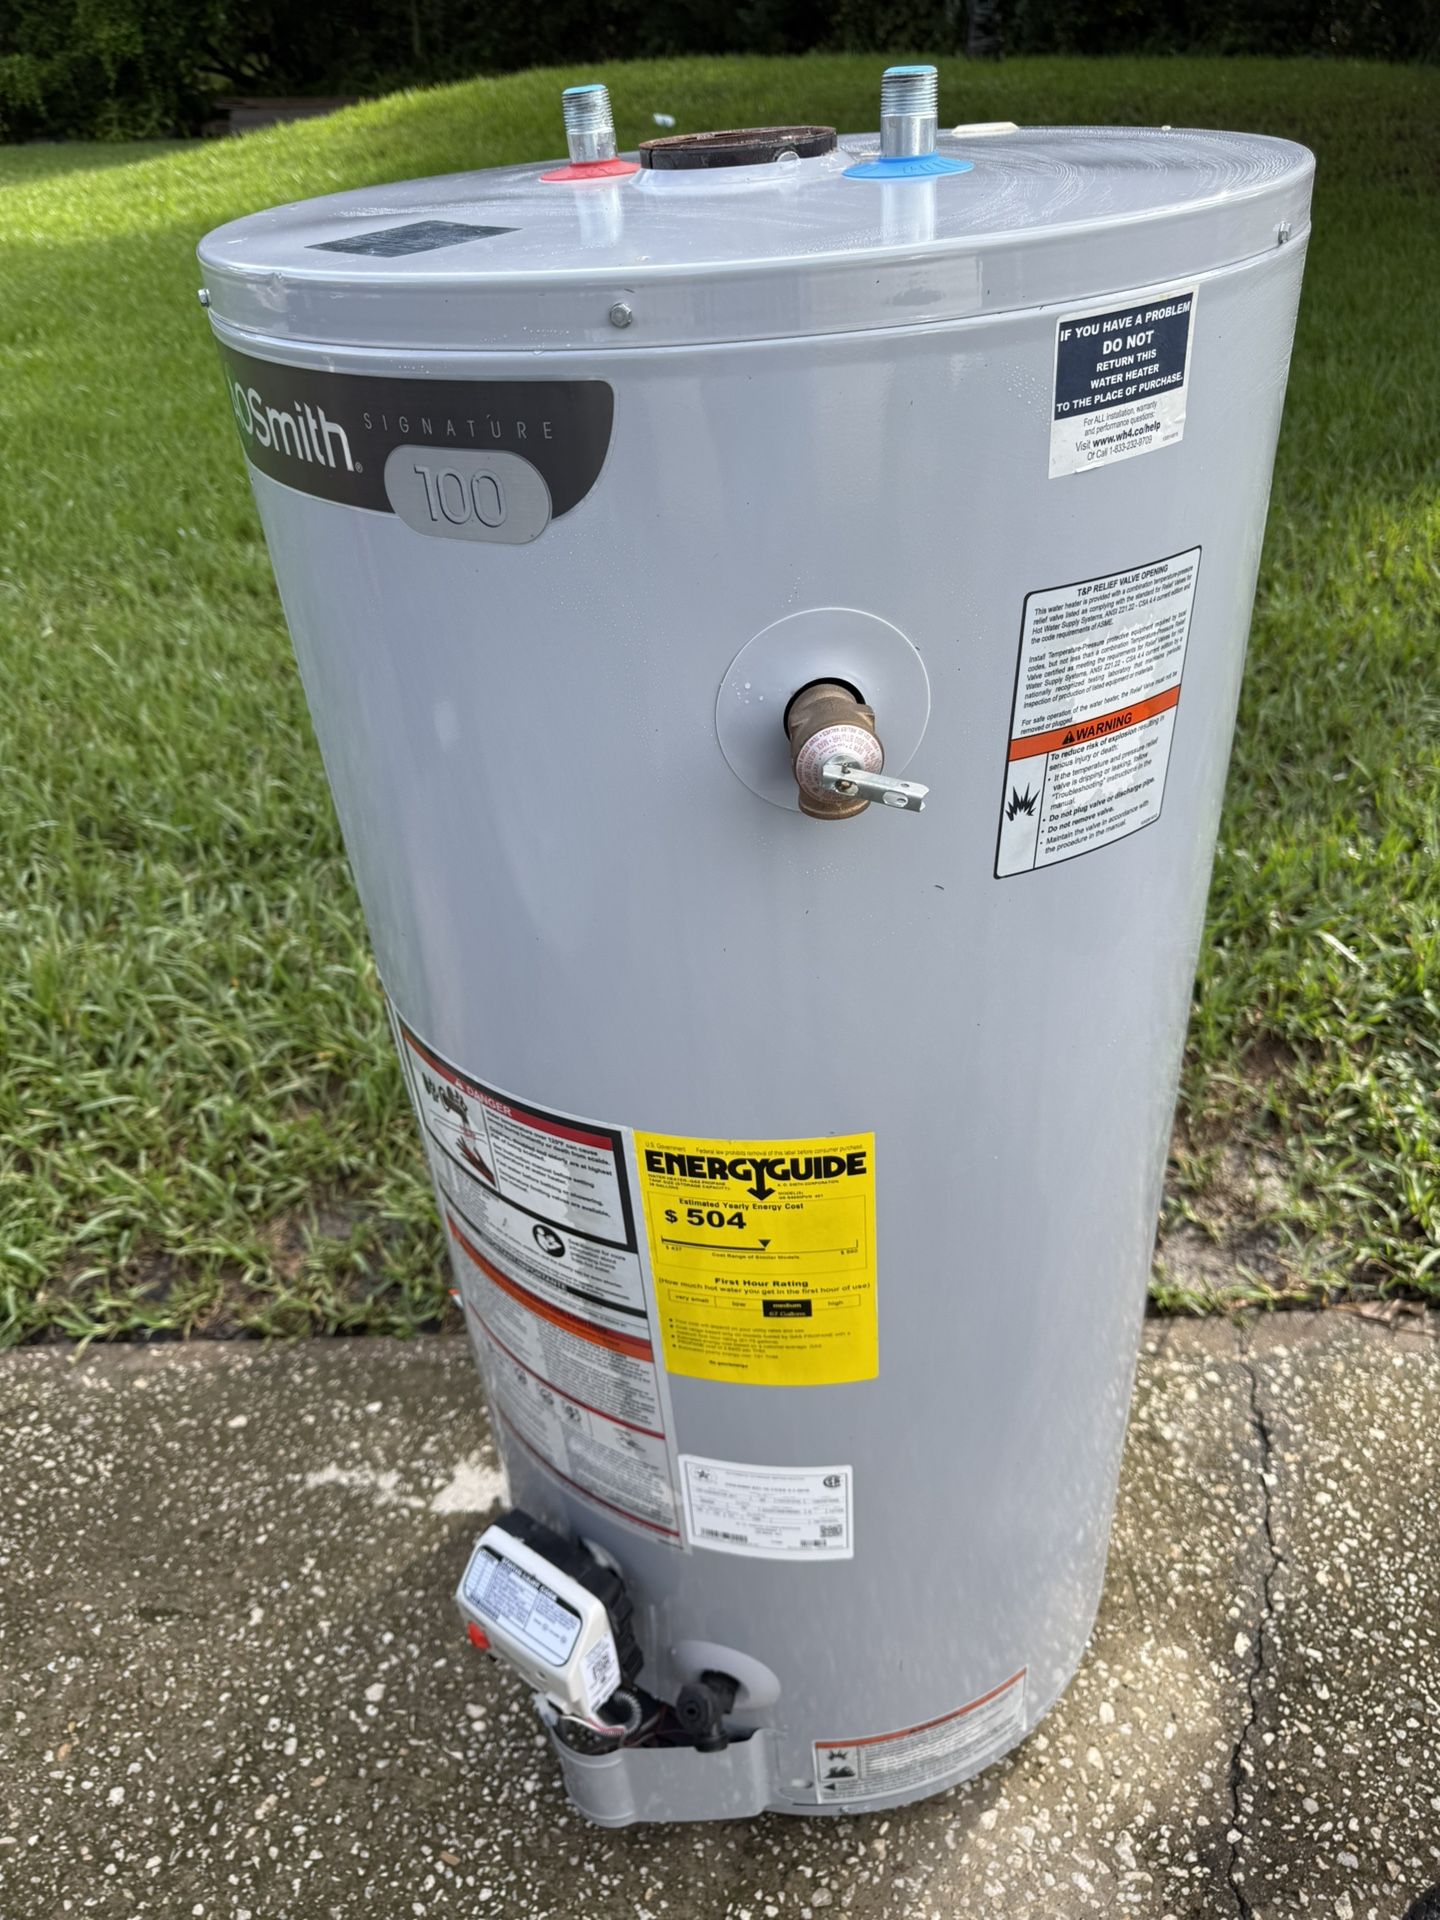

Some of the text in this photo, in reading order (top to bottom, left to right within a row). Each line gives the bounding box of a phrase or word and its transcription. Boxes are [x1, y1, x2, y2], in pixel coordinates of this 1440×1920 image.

[1060, 301, 1191, 342] IF YOU HAVE A PROBLEM
[1103, 330, 1154, 355] DO NOT
[1096, 349, 1156, 372] RETURN THIS
[1091, 364, 1159, 389] WATER HEATER
[1057, 372, 1183, 412] TO THE PLACE OF PURCHASE.
[363, 412, 553, 440] SIGNATURE
[1084, 418, 1094, 427] For
[1094, 414, 1105, 423] ALL
[1136, 401, 1157, 412] warranty
[1085, 428, 1095, 436] and
[1096, 419, 1129, 435] performance
[1076, 439, 1090, 451] Visit
[1087, 452, 1095, 460] Or
[1096, 447, 1108, 458] Call
[413, 464, 506, 527] 100
[1078, 564, 1168, 597] T&P RELIEF VALVE OPENING
[1033, 616, 1047, 625] relief
[1049, 614, 1063, 622] valve
[1066, 609, 1079, 618] listed
[1089, 602, 1114, 612] complying
[1065, 600, 1082, 609] heater
[1089, 593, 1110, 604] provided
[1044, 624, 1060, 632] Water
[1062, 619, 1080, 629] Supply
[1056, 626, 1090, 639] requirements
[1061, 747, 1085, 758] reduce
[1086, 741, 1099, 750] risk
[1108, 729, 1137, 743] explosion
[1138, 719, 1159, 731] resulting
[1076, 713, 1132, 741] WARNING
[1049, 760, 1073, 771] serious
[1075, 754, 1091, 764] injury
[1073, 759, 1109, 776] temperature
[1110, 754, 1120, 762] and
[1122, 745, 1145, 758] pressure
[1146, 737, 1158, 747] relief
[1054, 781, 1071, 791] valve
[1079, 771, 1102, 785] dripping
[1134, 753, 1148, 762] follow
[1061, 810, 1072, 818] not
[1073, 805, 1088, 816] plug
[1090, 797, 1105, 808] valve
[1115, 783, 1142, 799] discharge
[1046, 830, 1073, 844] Maintain
[1075, 827, 1084, 836] the
[1086, 822, 1100, 832] valve
[1108, 806, 1138, 823] accordance
[1059, 821, 1070, 829] not
[1072, 813, 1095, 825] remove
[1057, 836, 1087, 851] procedure
[1096, 829, 1104, 837] the
[467, 1086, 512, 1117] DANGER
[645, 1149, 866, 1183] ENERGYGUIDE
[679, 1198, 719, 1208] Estimated
[722, 1201, 749, 1210] Yearly
[752, 1202, 782, 1211] Energy
[665, 1208, 746, 1229] $ 504
